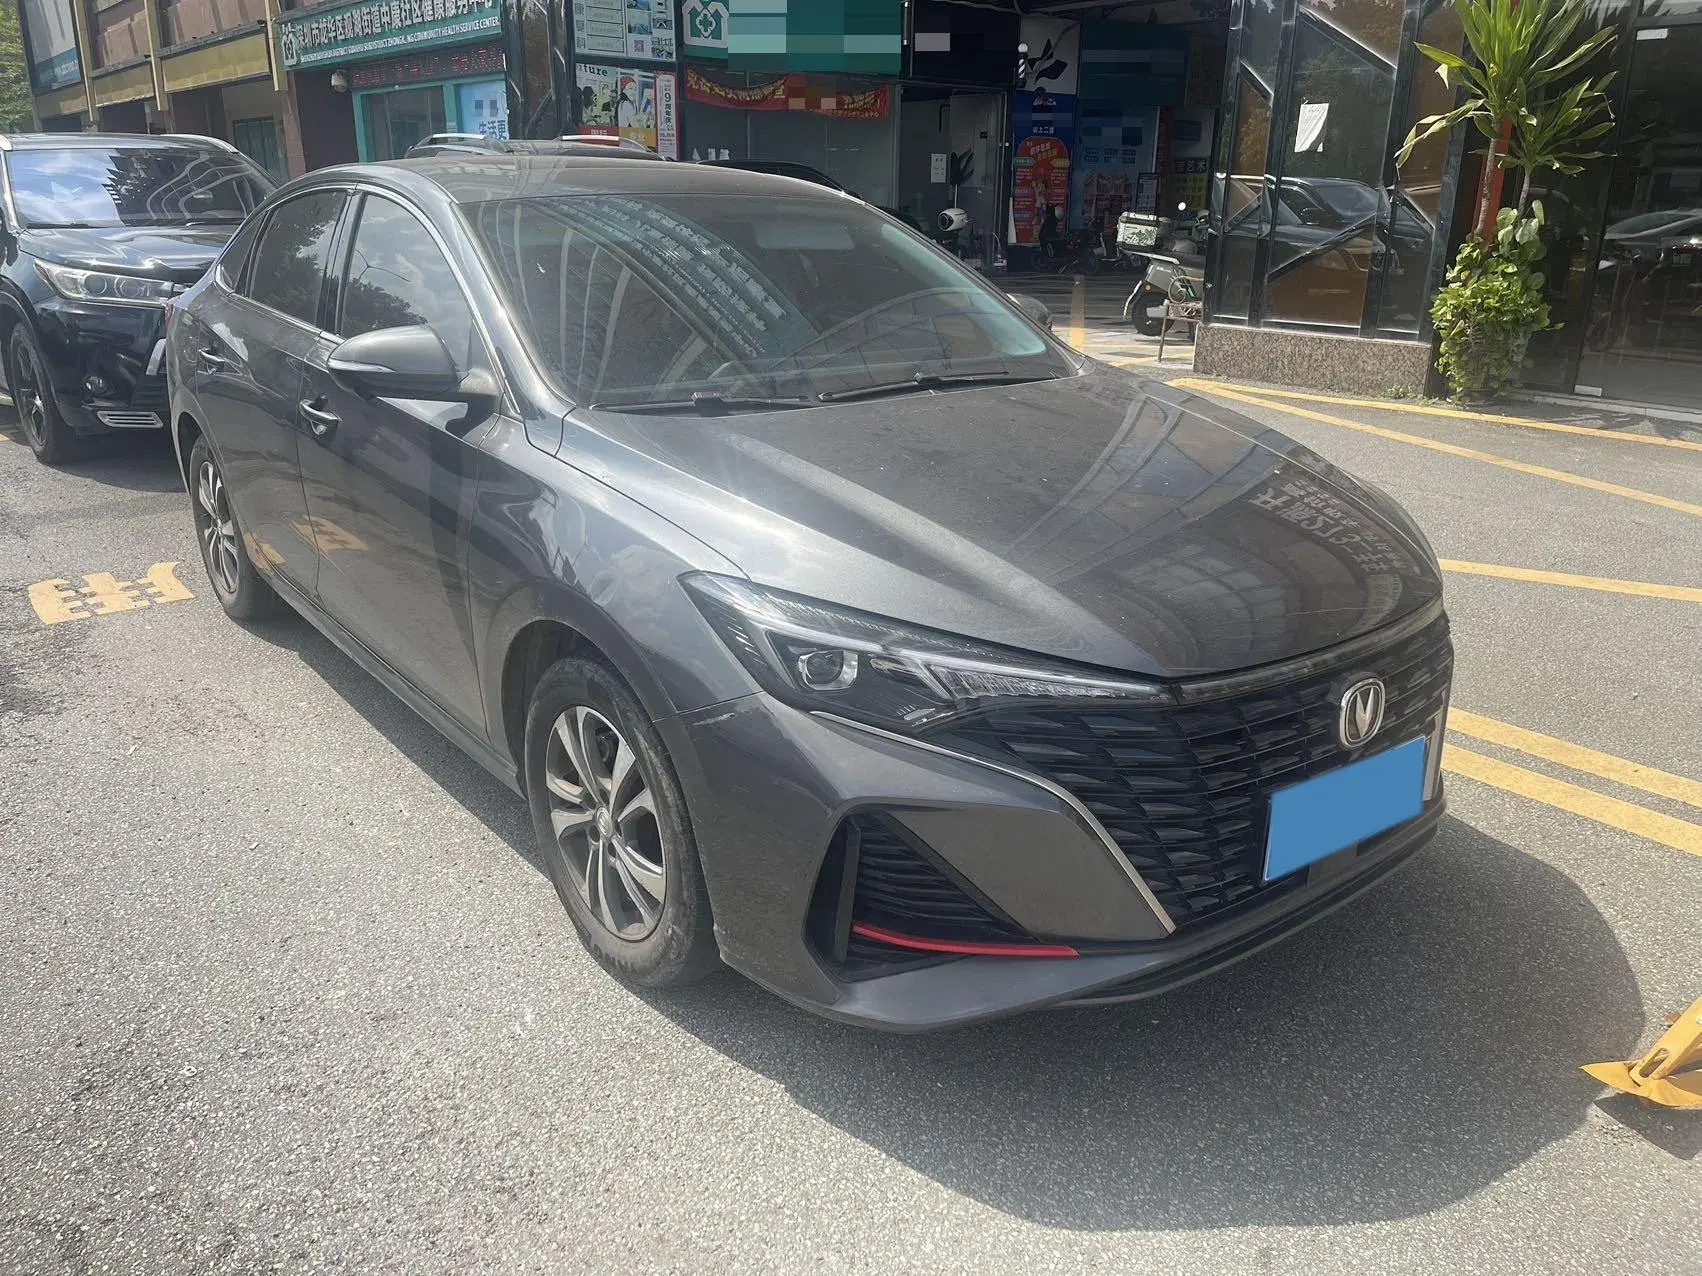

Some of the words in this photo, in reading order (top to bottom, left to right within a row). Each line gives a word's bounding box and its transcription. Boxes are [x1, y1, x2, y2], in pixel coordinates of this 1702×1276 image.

[442, 24, 460, 36] HEALTH
[460, 20, 480, 32] SERVICE
[480, 16, 500, 28] CENTER
